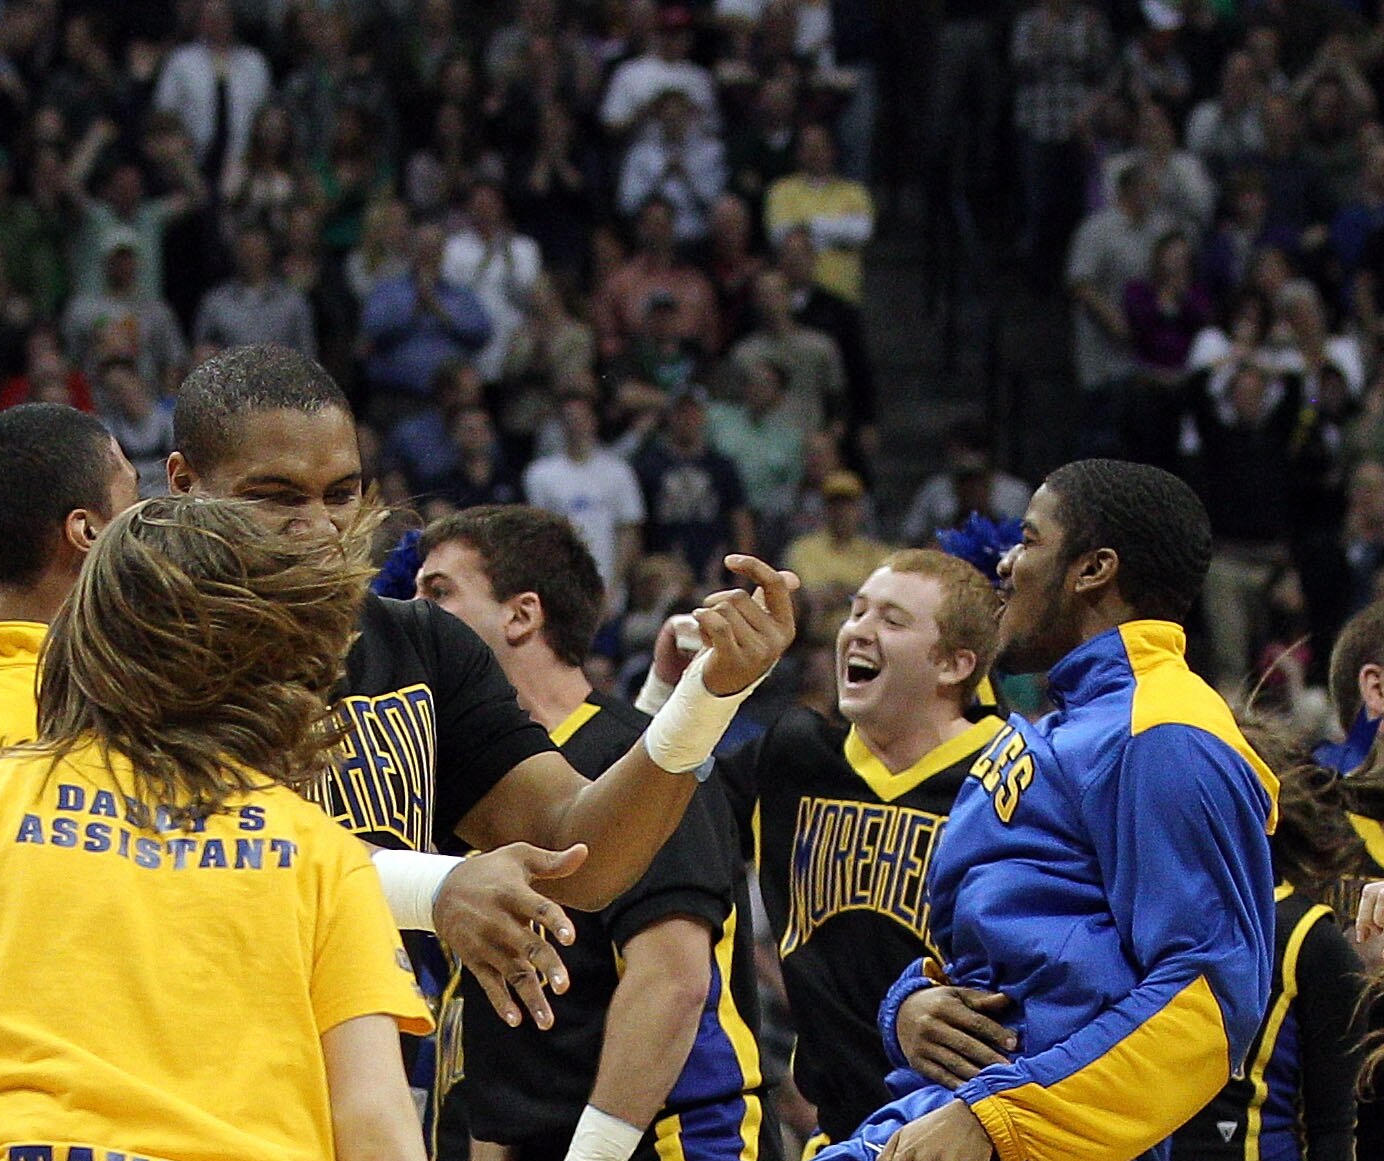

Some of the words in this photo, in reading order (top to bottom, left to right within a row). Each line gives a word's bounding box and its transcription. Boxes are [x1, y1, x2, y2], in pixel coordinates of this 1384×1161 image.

[56, 784, 266, 833] DADDS
[310, 682, 437, 853] HEAD
[969, 724, 1036, 824] LES
[16, 813, 298, 871] ASSISTANT
[779, 796, 951, 968] MOREHE
